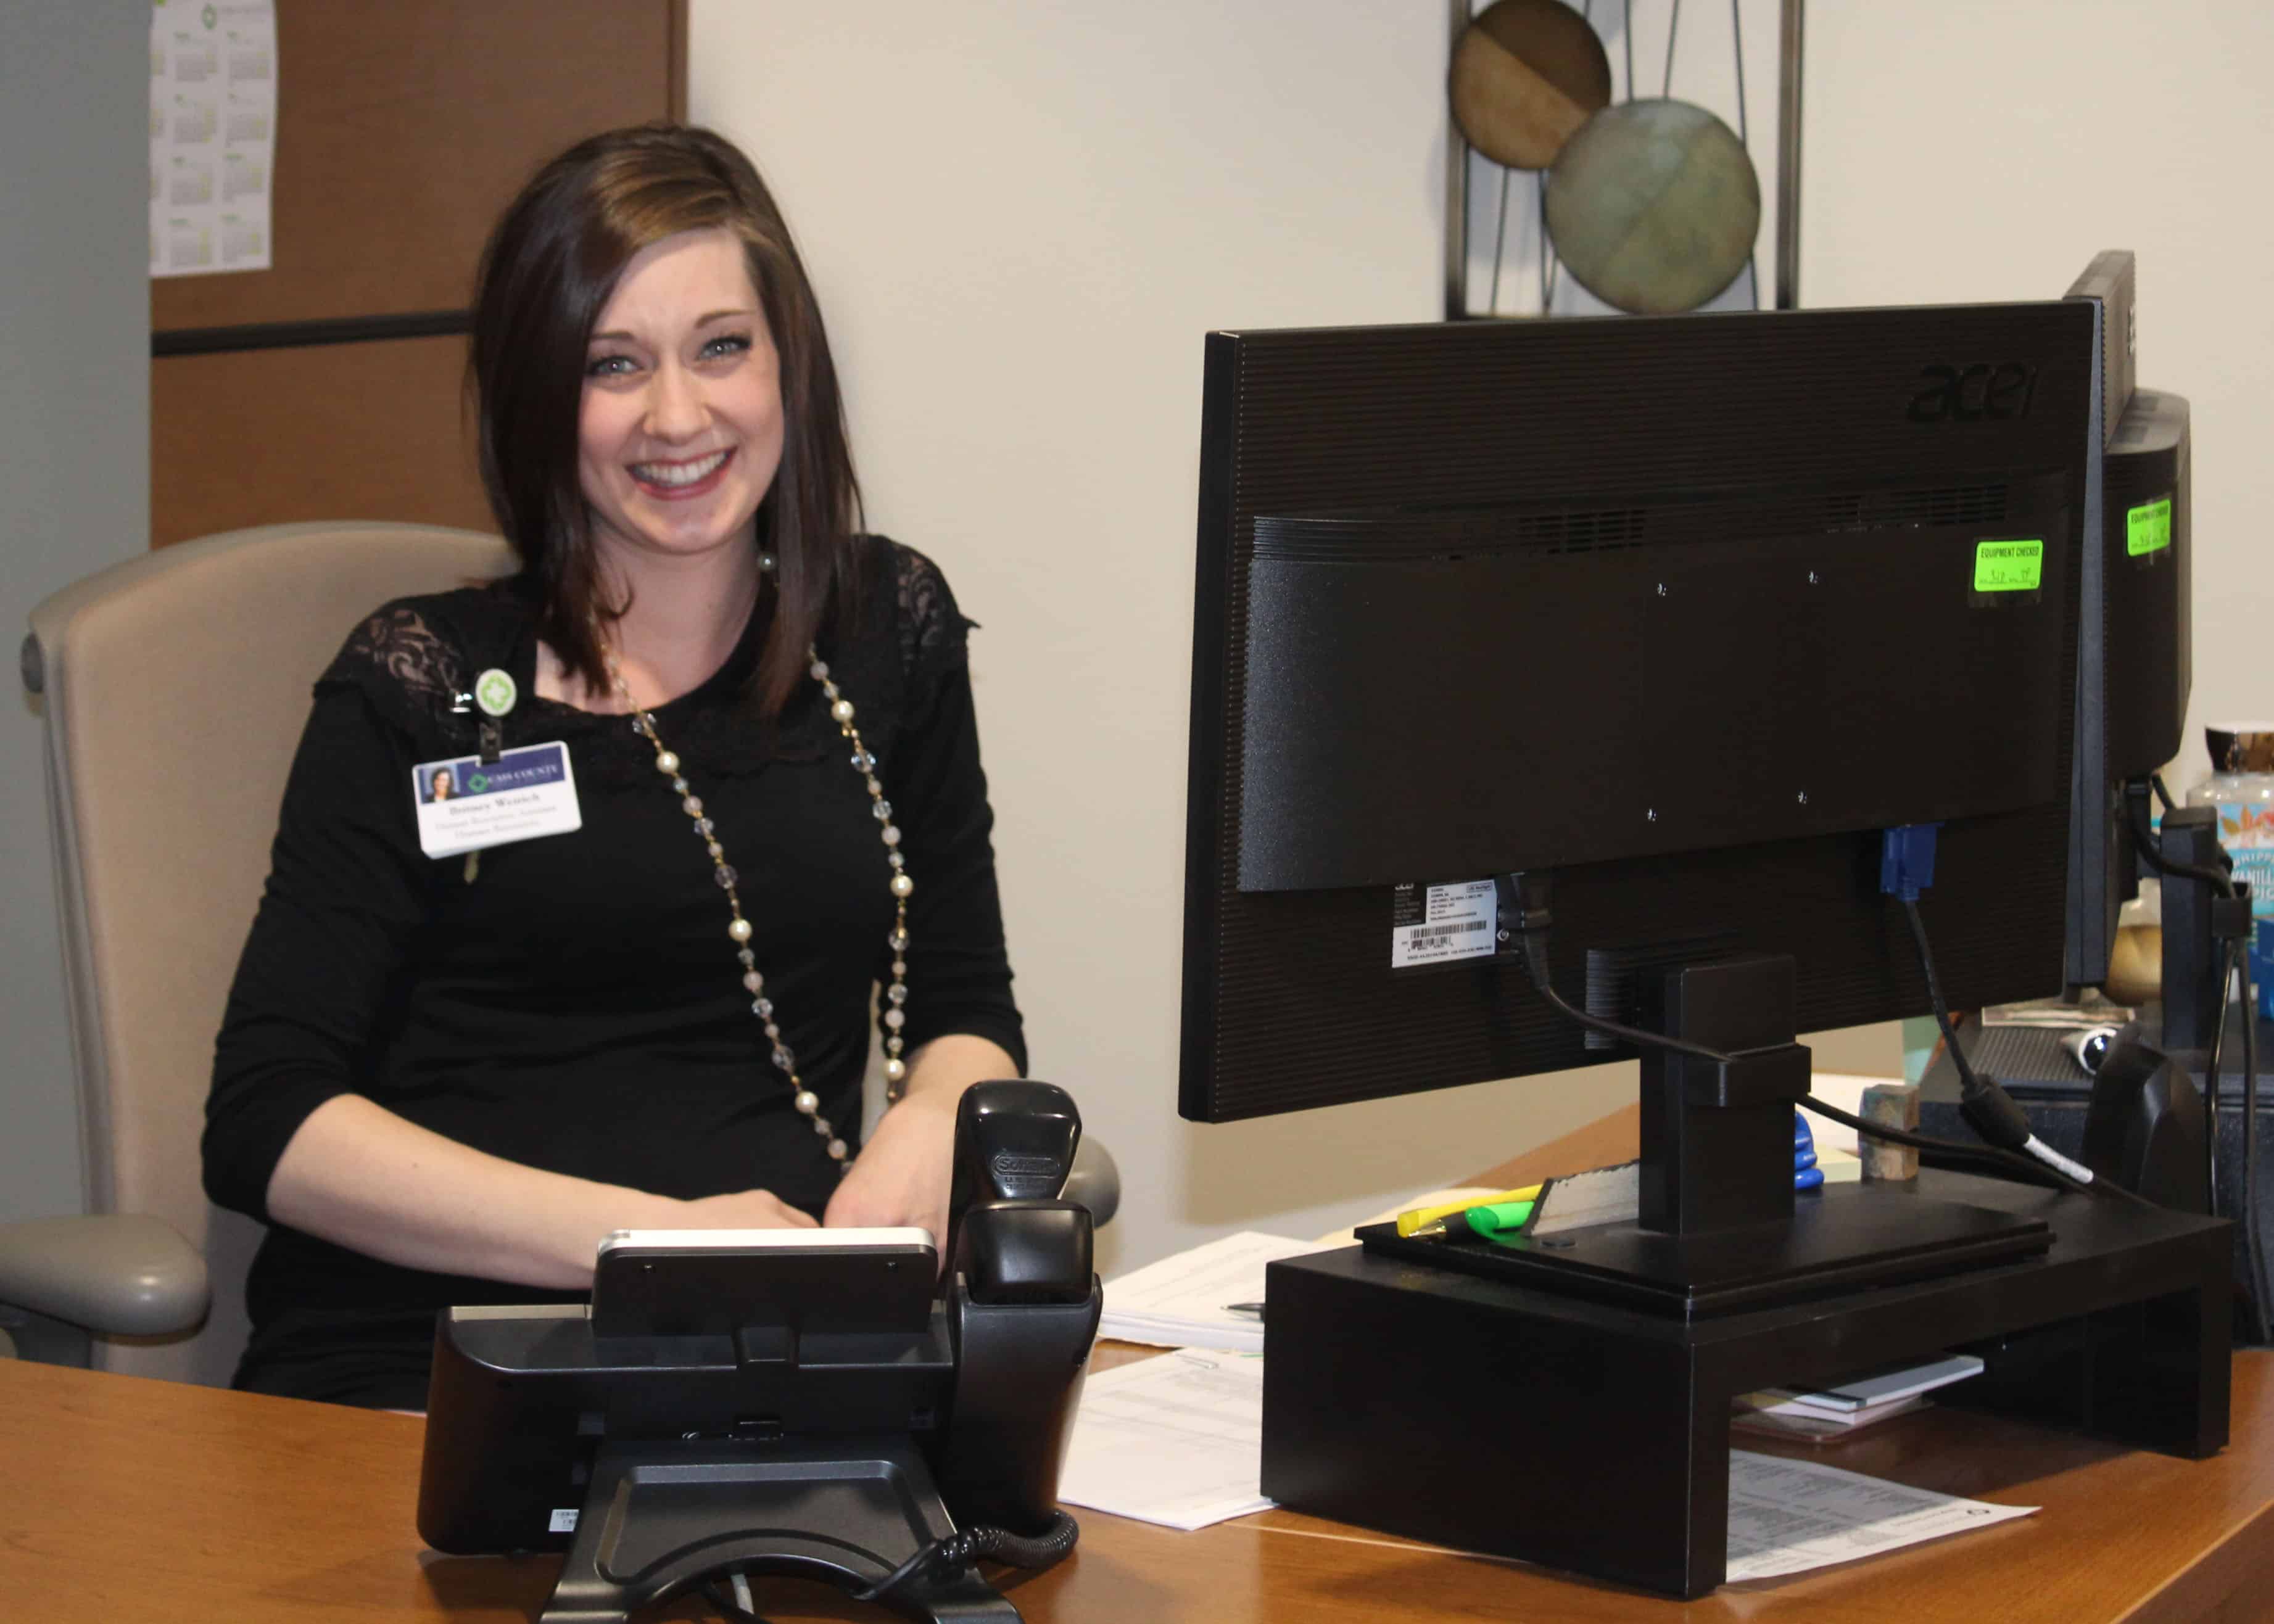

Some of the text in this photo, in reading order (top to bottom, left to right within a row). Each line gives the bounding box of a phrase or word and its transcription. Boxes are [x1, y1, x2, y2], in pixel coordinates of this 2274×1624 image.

[1906, 363, 2038, 424] acer
[1981, 546, 2039, 558] EQUIPMENT CHECKED
